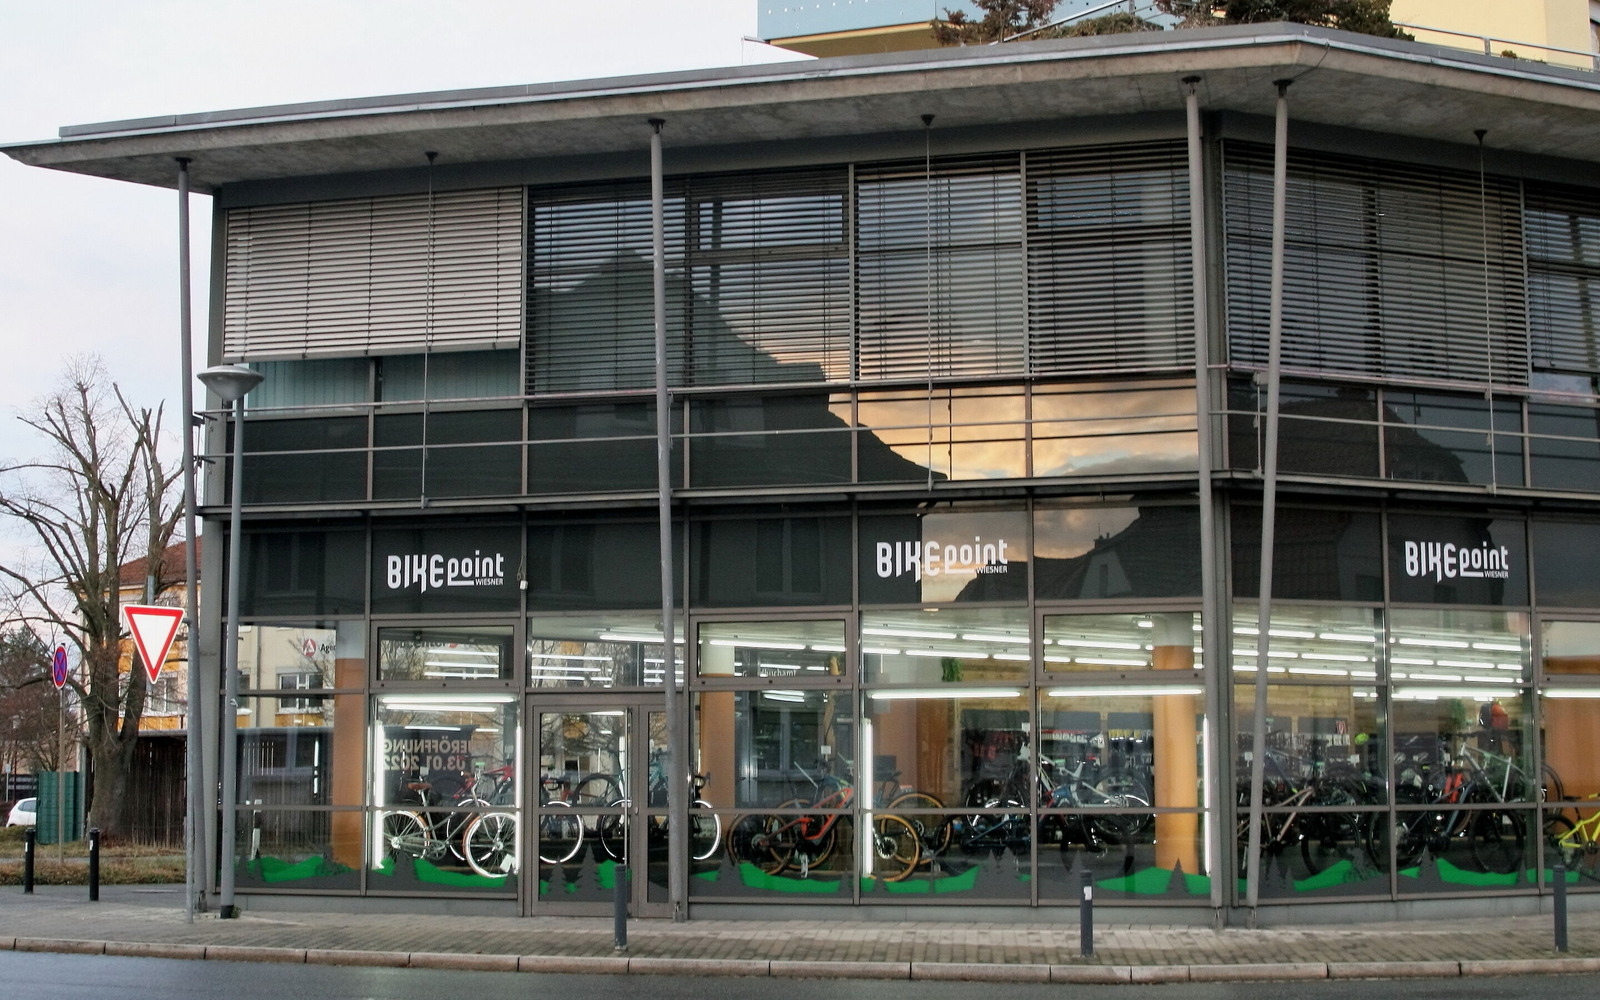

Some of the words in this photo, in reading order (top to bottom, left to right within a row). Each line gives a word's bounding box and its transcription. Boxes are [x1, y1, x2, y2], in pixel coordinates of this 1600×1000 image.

[387, 550, 504, 594] BIKEpoint
[877, 536, 1007, 583] BIKEpoint
[976, 565, 1008, 574] WIESNER
[1405, 541, 1509, 583] BIKEpoint
[475, 578, 504, 586] WIESNER
[1484, 570, 1509, 578] WIESNER
